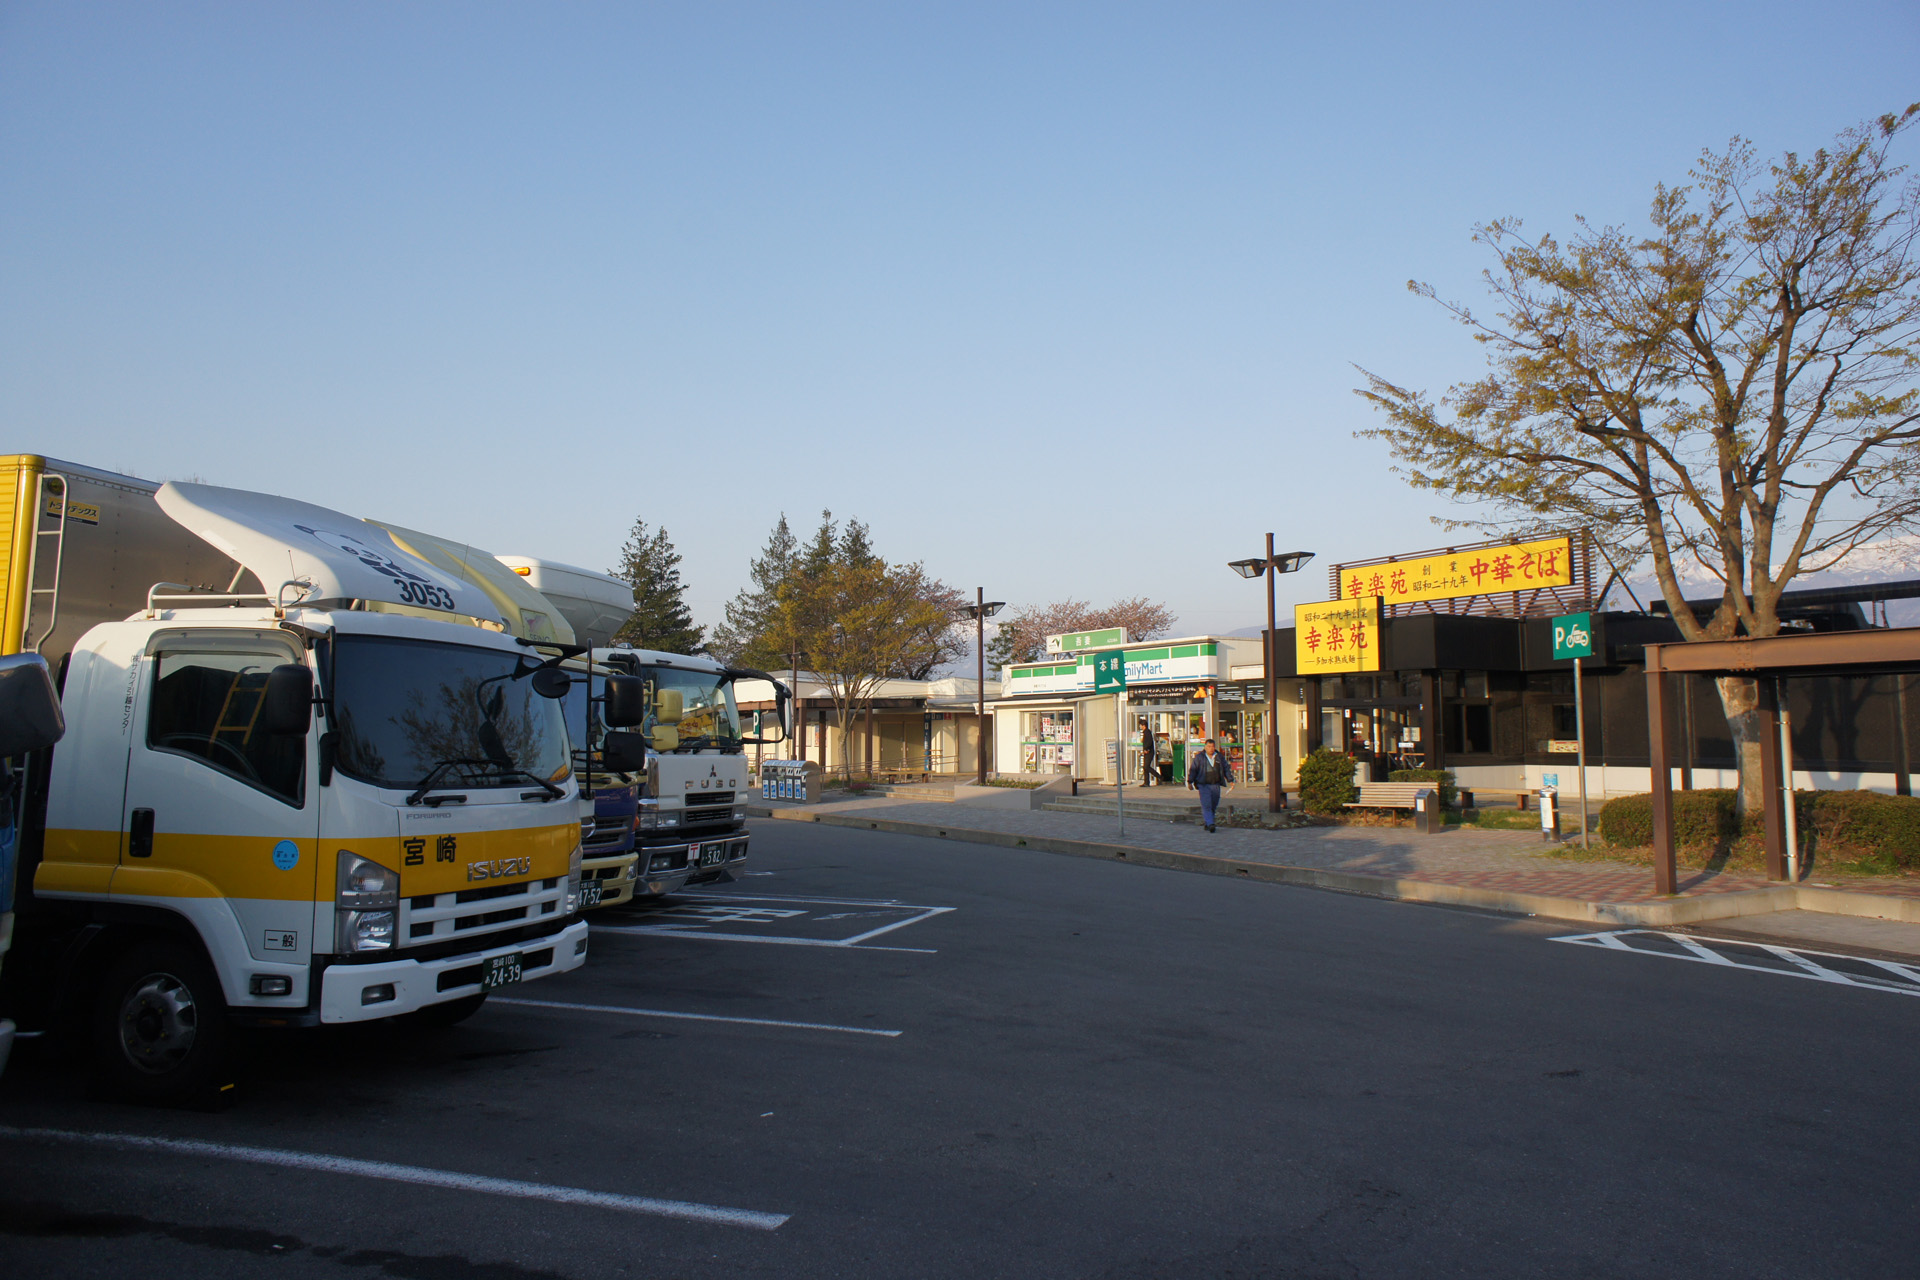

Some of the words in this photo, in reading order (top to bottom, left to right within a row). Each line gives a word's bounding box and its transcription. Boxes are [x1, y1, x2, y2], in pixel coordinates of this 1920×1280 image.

[1469, 547, 1564, 588] 中華そば
[393, 578, 455, 610] 3053
[1304, 621, 1368, 654] 幸楽苑
[1555, 626, 1566, 650] P
[753, 711, 760, 733] P
[685, 780, 736, 790] FUSO
[406, 812, 452, 820] FORWARD
[403, 834, 457, 867] 宮崎
[467, 856, 531, 882] ISUZU
[267, 934, 295, 948] 一般
[490, 964, 521, 988] 24-39
